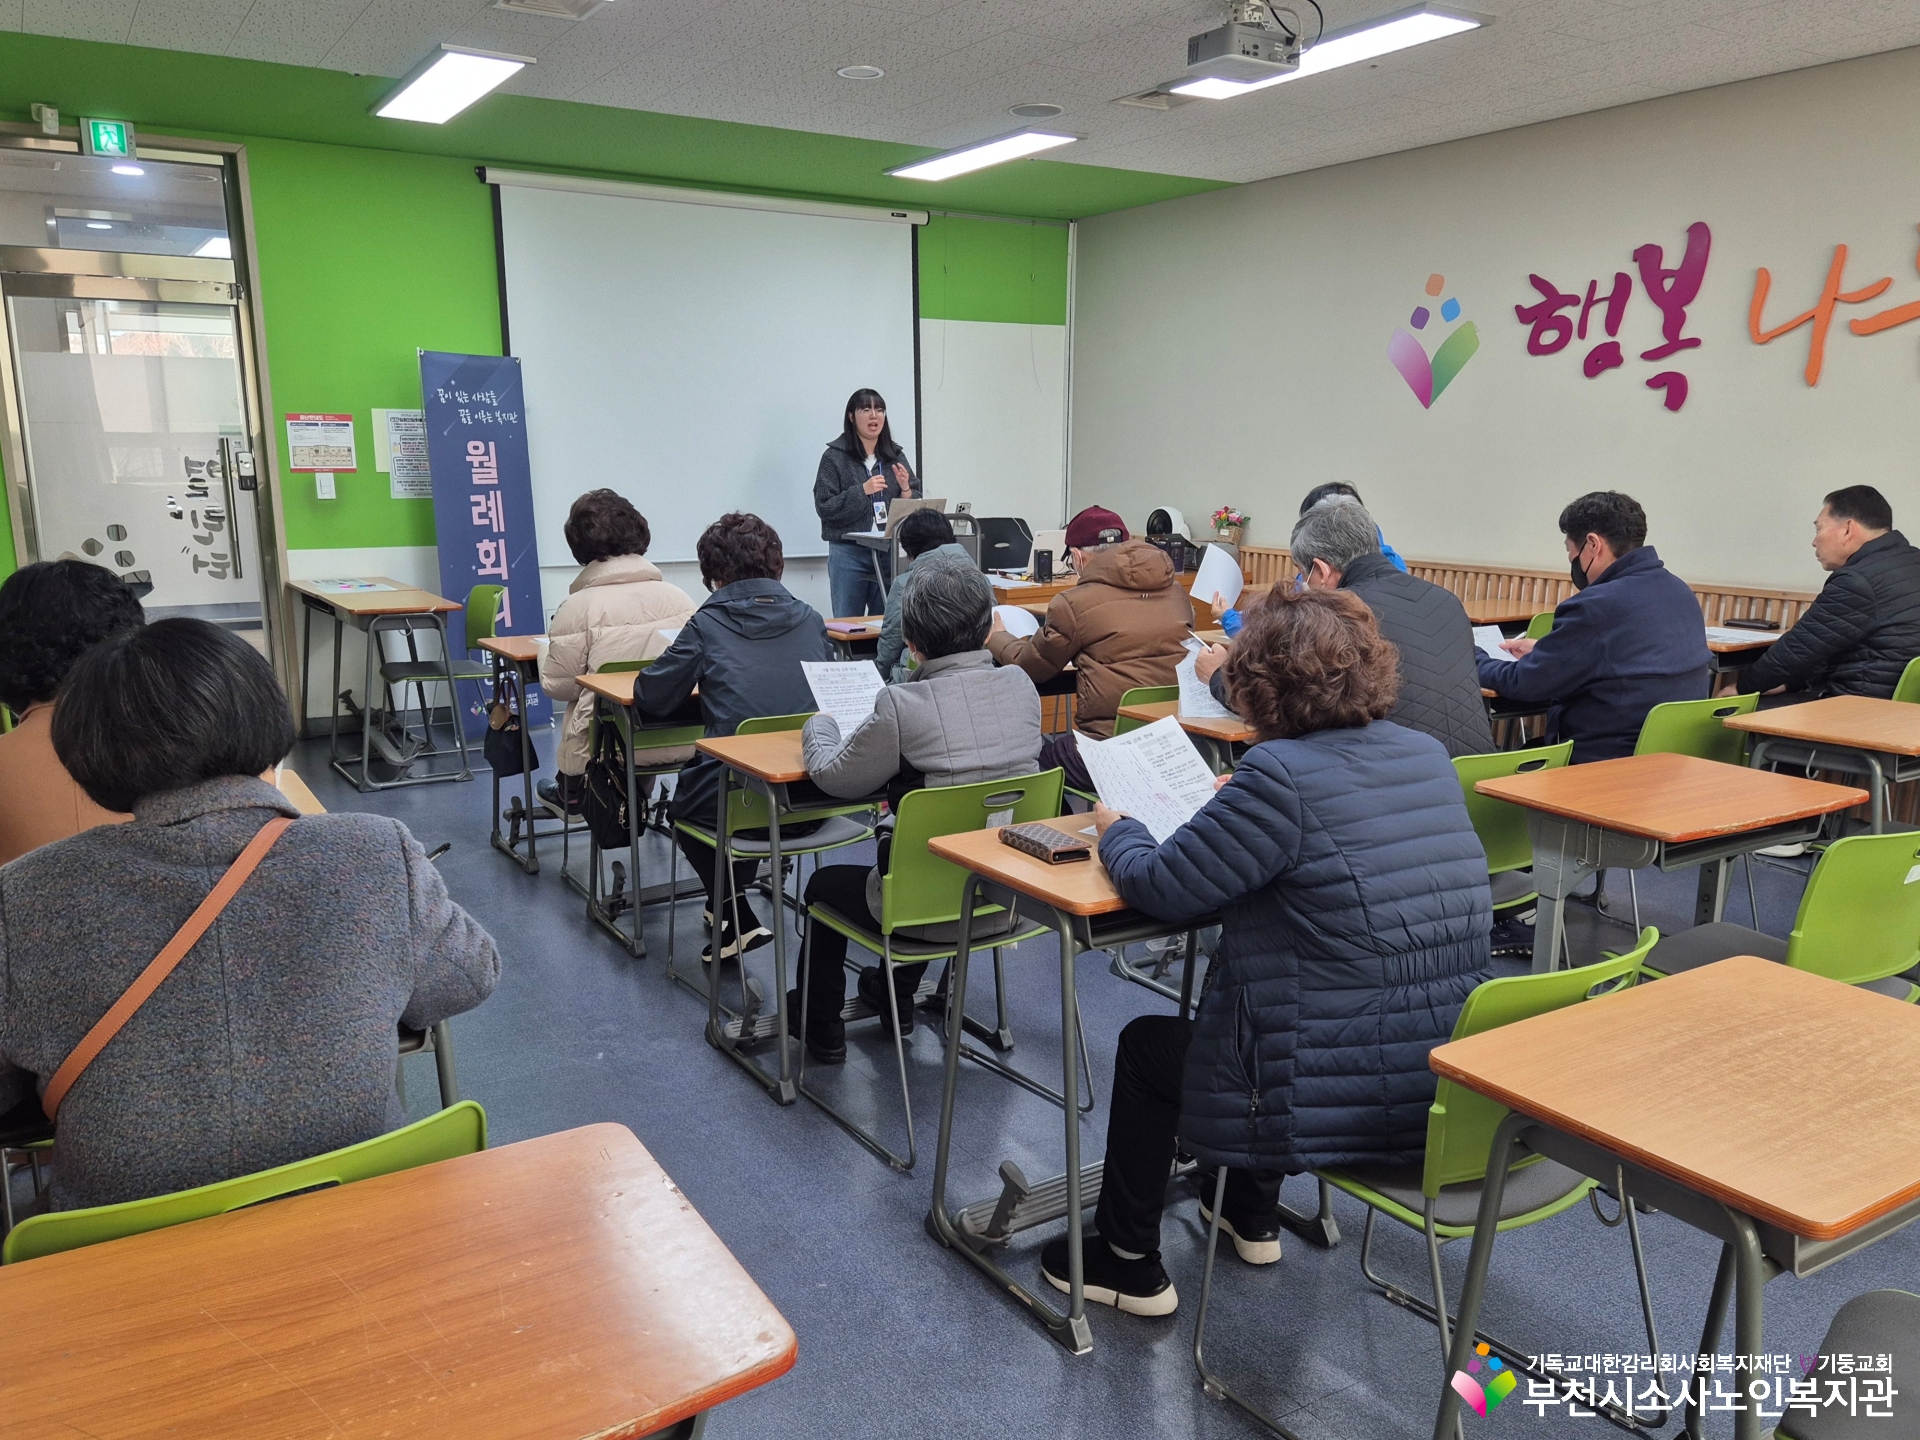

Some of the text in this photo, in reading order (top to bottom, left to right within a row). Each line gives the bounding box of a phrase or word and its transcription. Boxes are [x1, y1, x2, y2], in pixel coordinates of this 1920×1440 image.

[1515, 221, 1712, 412] 행복
[437, 388, 498, 406] 꿈이 있는 사람들
[458, 409, 518, 425] 꿈을 이루는 복지관
